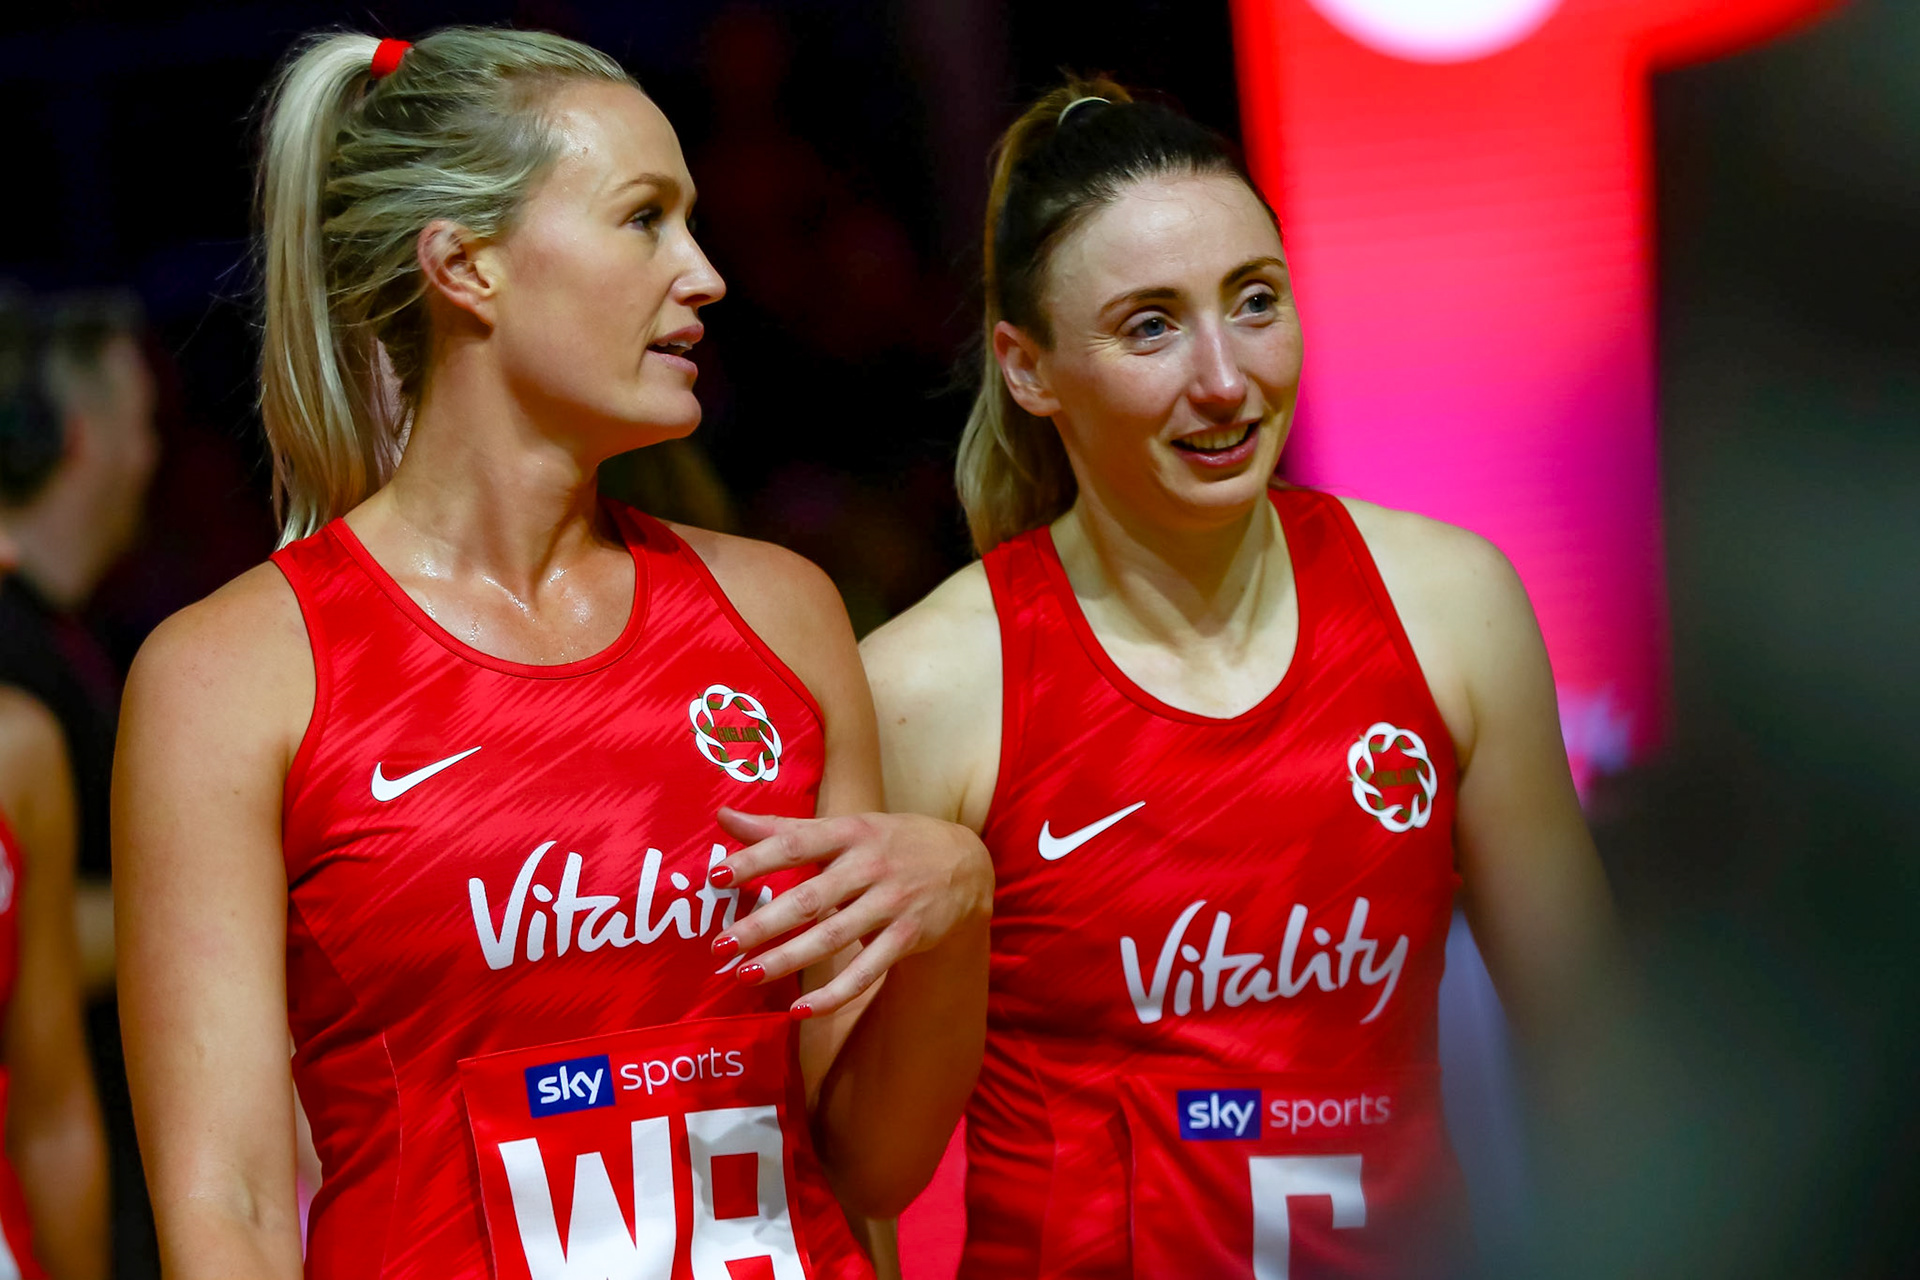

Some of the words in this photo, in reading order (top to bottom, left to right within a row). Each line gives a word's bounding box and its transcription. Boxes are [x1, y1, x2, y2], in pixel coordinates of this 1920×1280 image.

[1119, 896, 1409, 1024] Vitality
[537, 1066, 603, 1105] sky
[619, 1047, 745, 1094] sports
[1188, 1093, 1255, 1136] sky
[1269, 1092, 1391, 1134] sports
